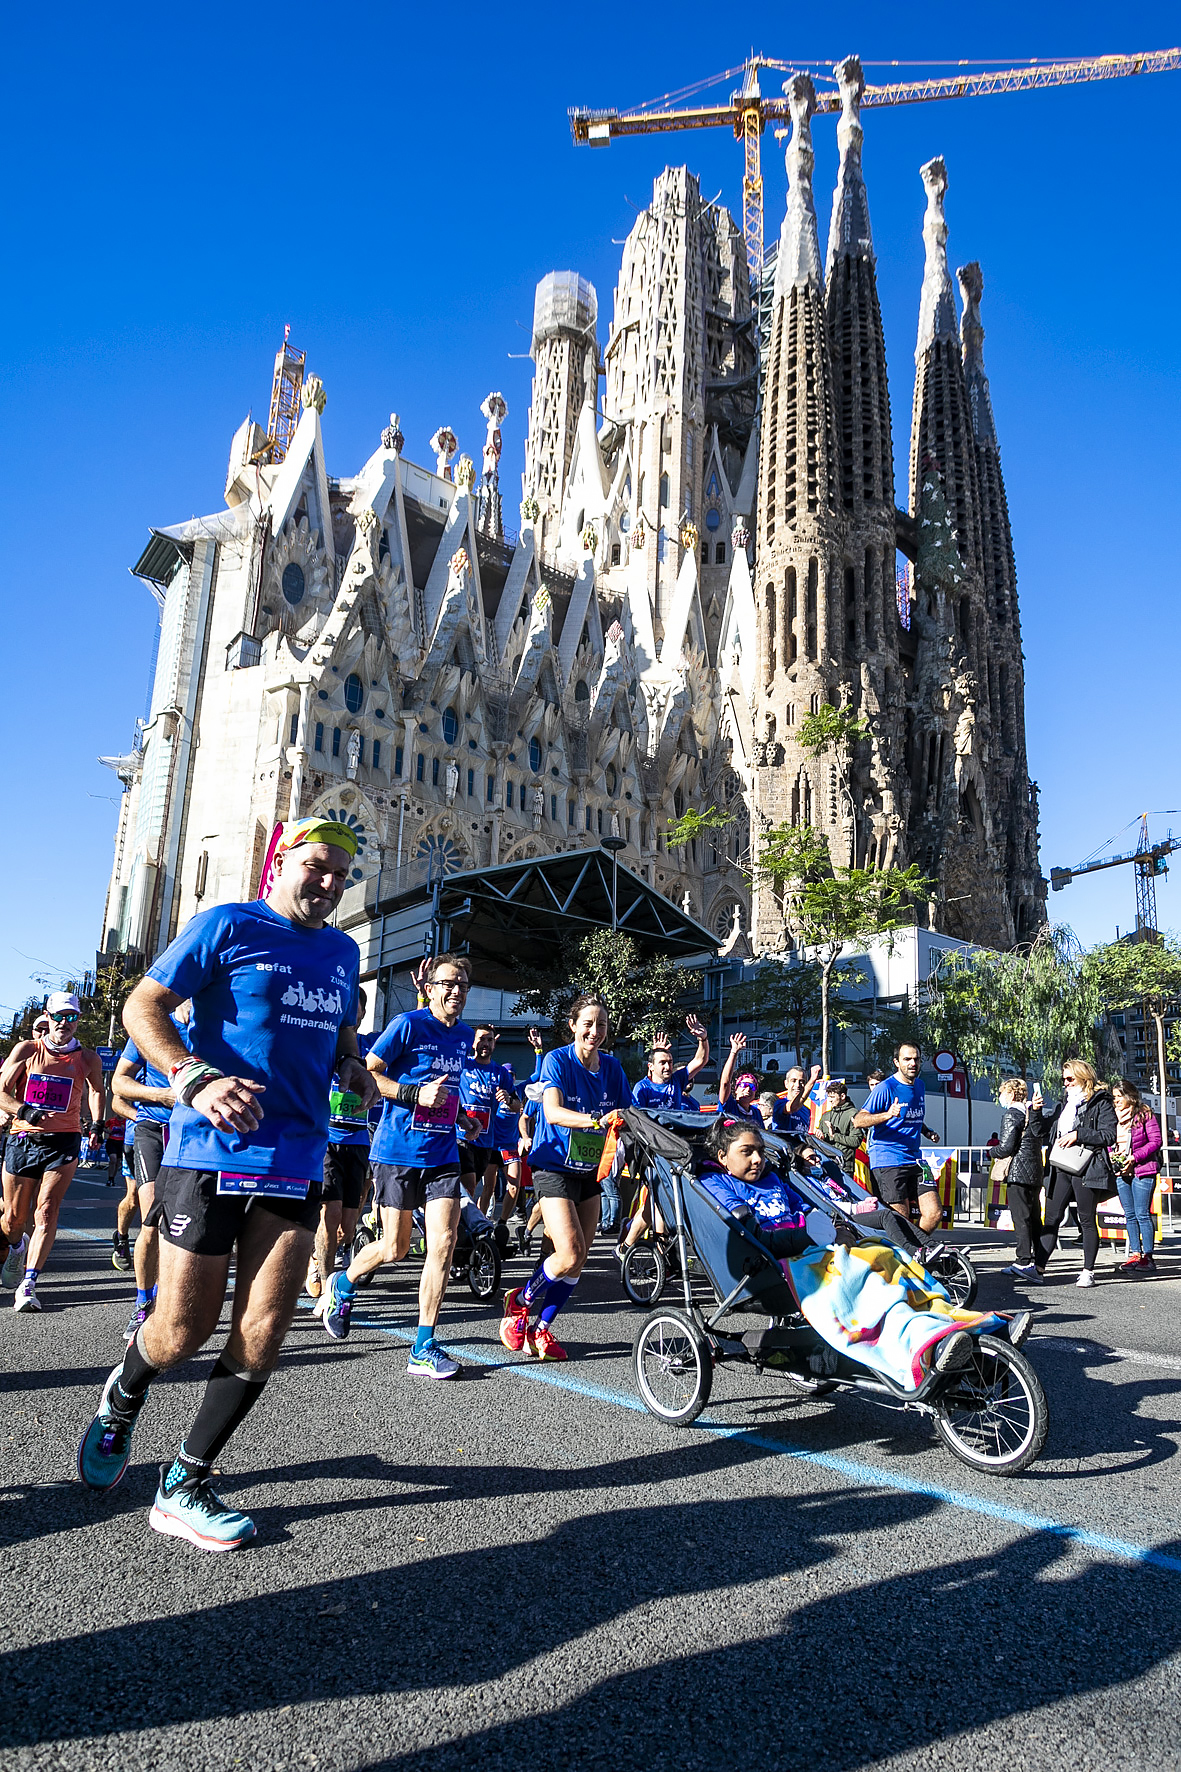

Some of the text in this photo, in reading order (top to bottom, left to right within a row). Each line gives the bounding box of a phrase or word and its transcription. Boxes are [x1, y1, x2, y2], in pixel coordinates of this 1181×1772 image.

[255, 962, 293, 975] aefat
[280, 1013, 338, 1034] #Imparables
[32, 1090, 63, 1101] 10131
[428, 1106, 450, 1119] 885
[577, 1145, 602, 1160] 1309
